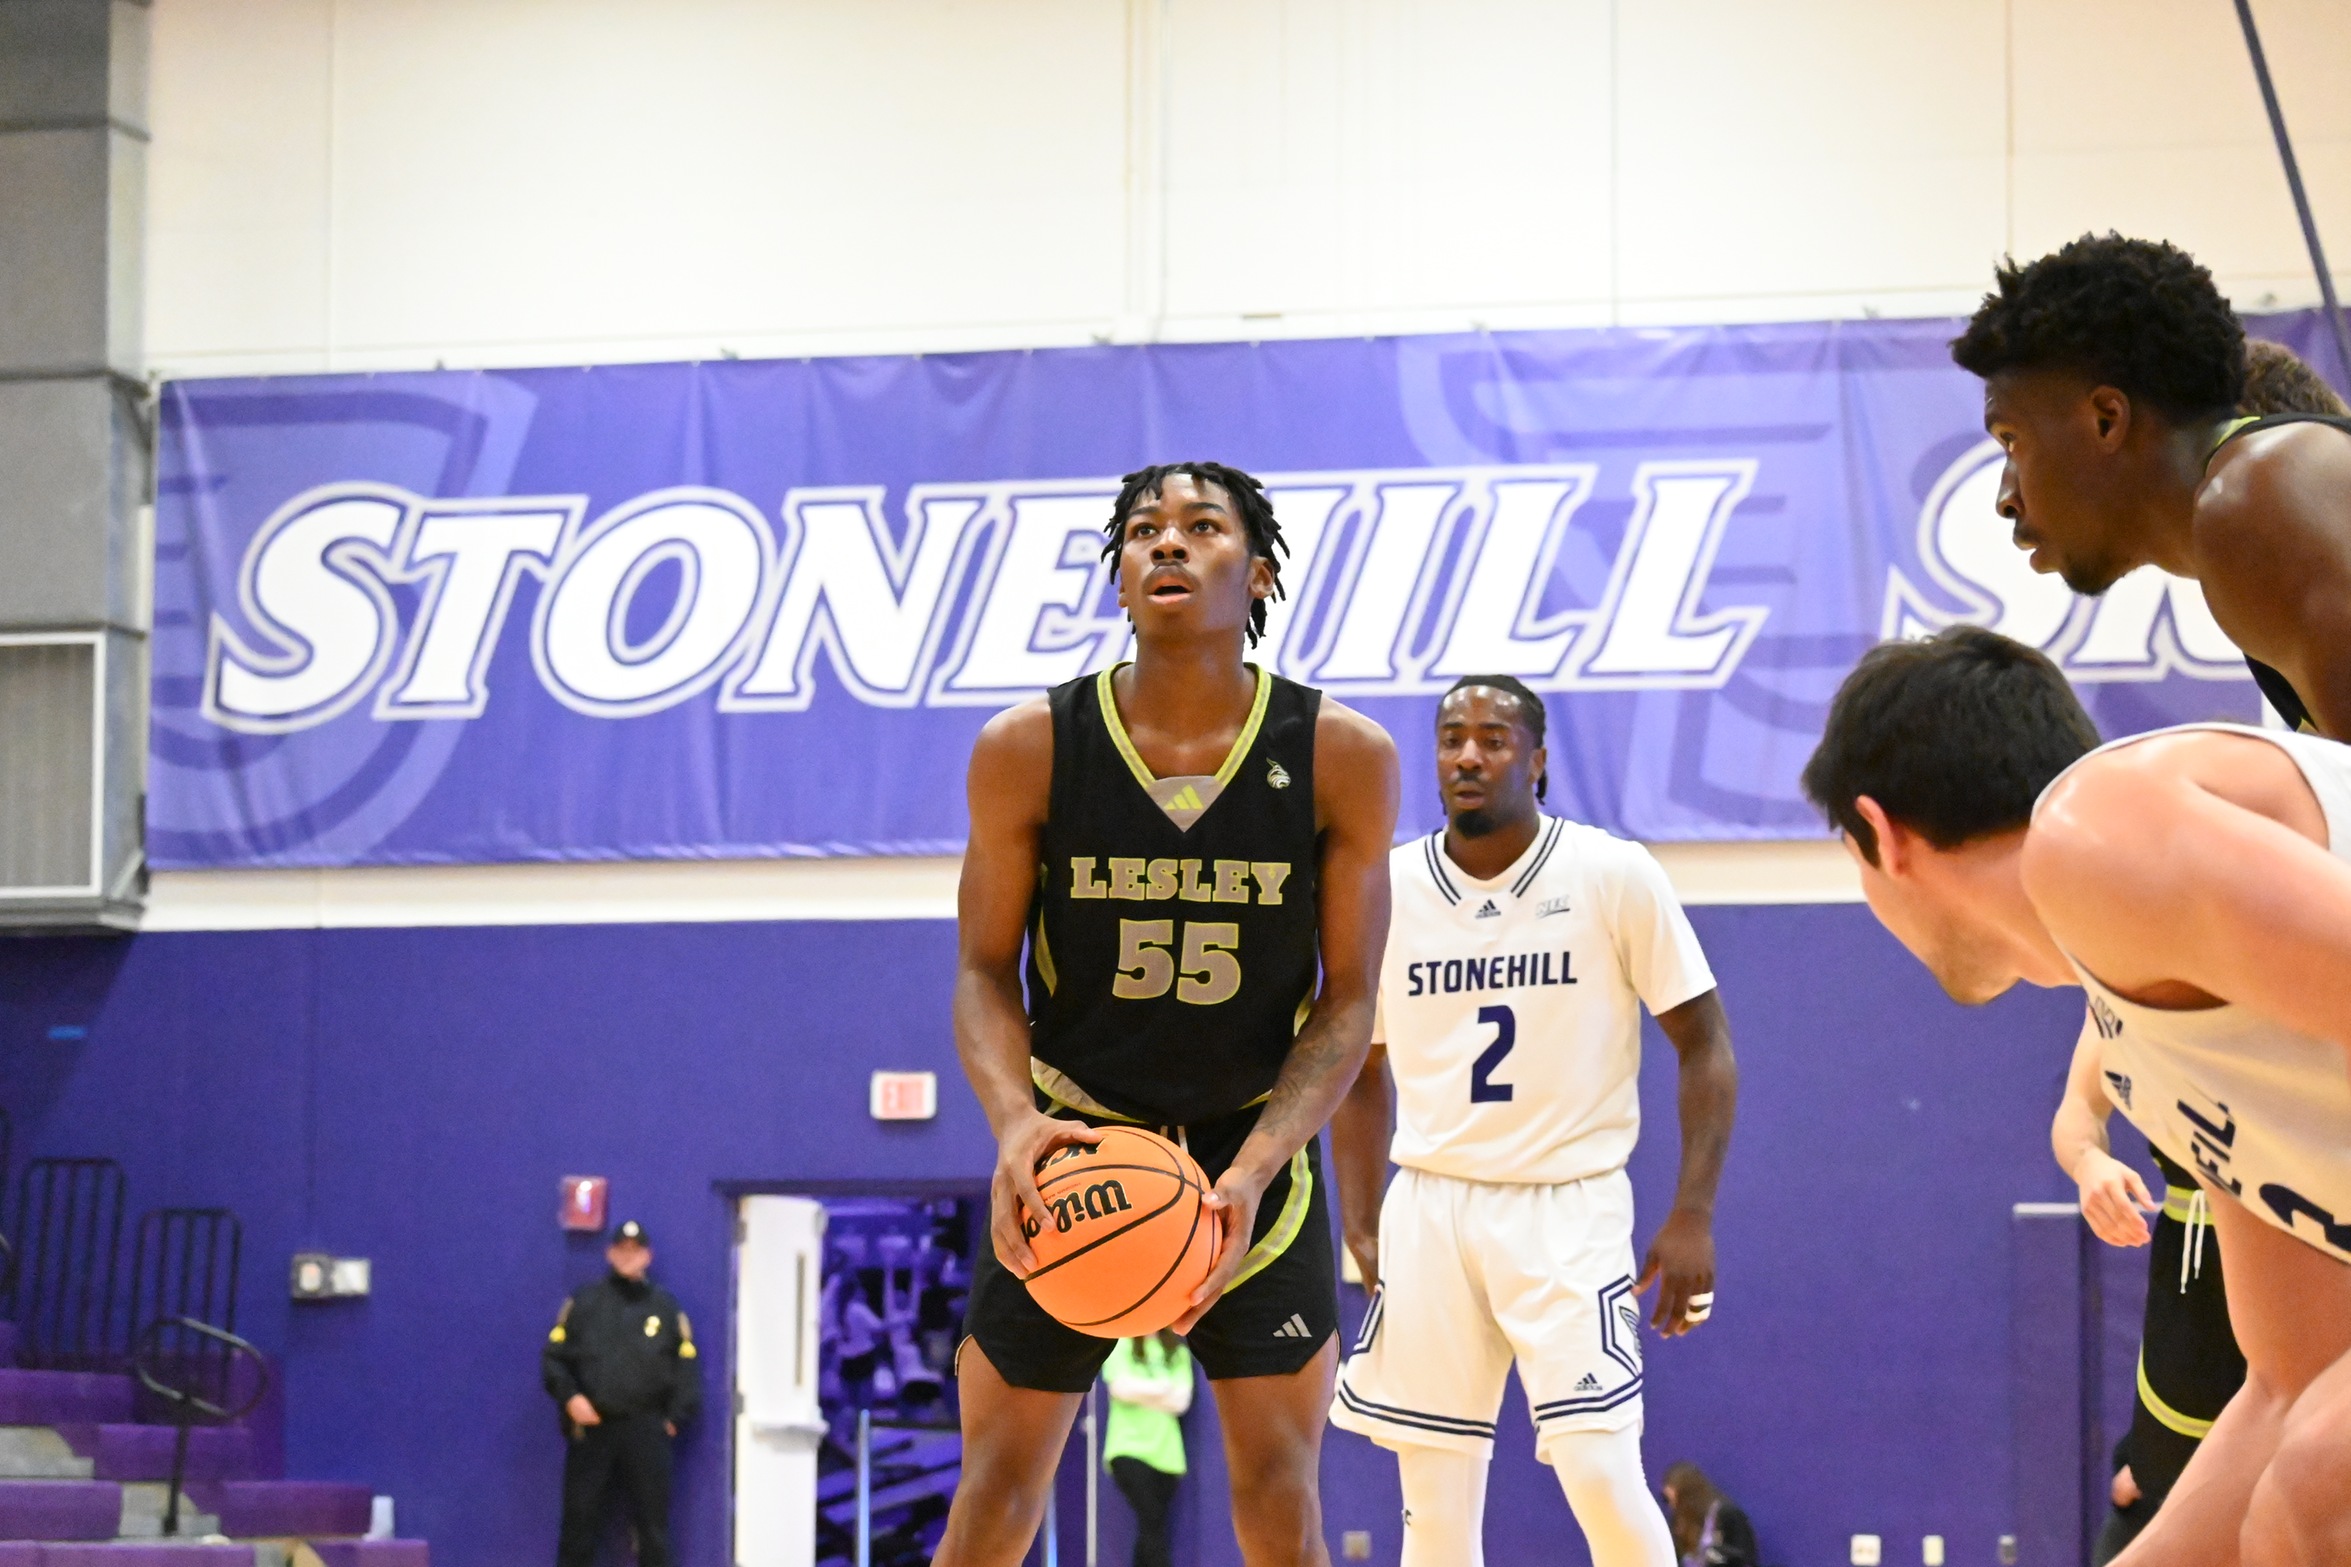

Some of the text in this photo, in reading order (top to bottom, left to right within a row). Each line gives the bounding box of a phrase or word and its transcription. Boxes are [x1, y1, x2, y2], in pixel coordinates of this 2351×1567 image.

[1071, 857, 1291, 905] LESLEY
[1112, 918, 1241, 1005] 55
[1408, 951, 1578, 996] STONEHILL
[1470, 1004, 1516, 1103] 2
